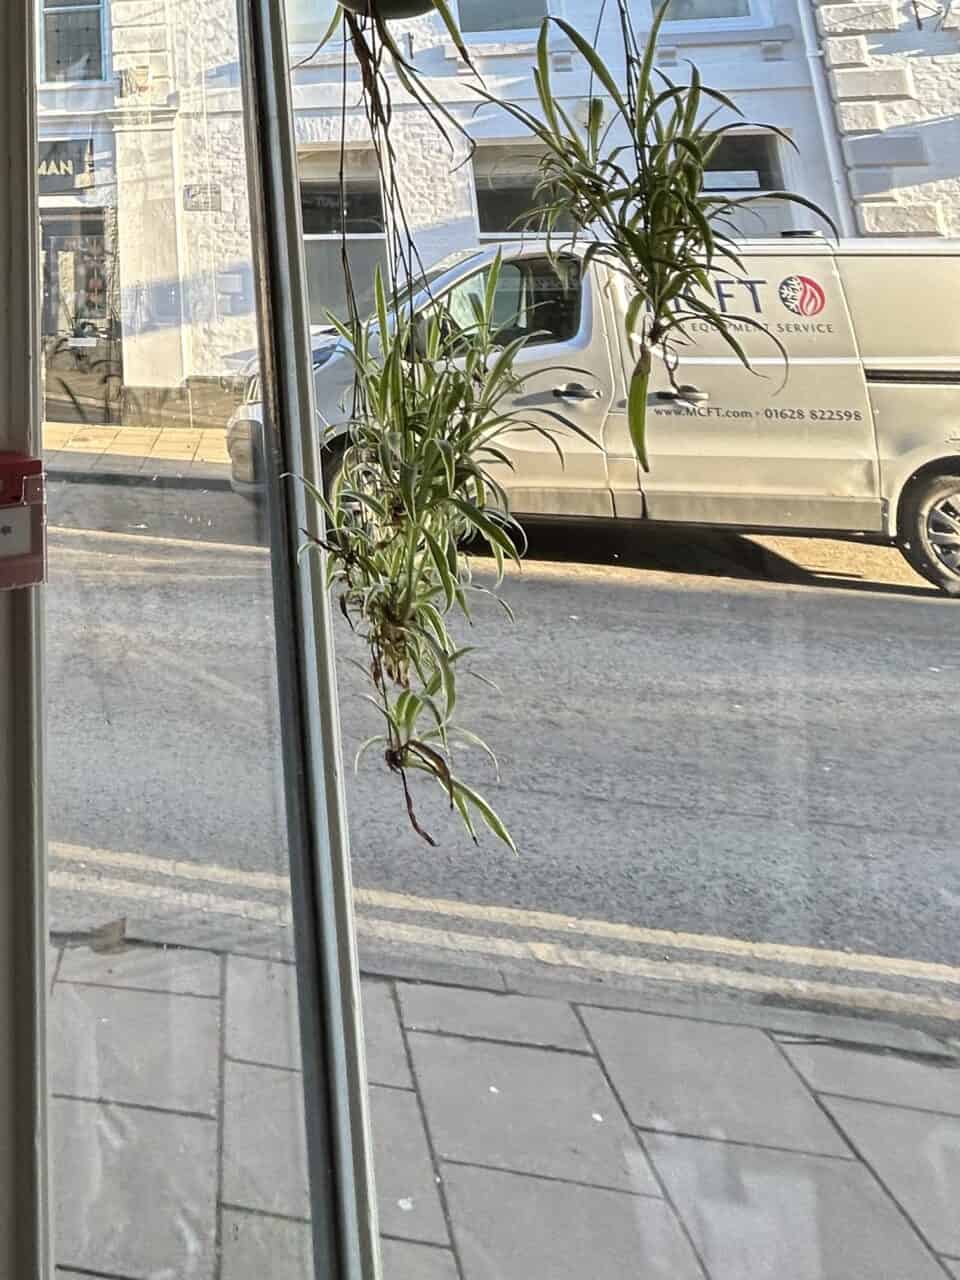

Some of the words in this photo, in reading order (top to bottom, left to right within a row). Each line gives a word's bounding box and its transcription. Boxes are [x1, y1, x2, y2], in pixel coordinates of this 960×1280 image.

[778, 323, 833, 333] SERVICE
[654, 406, 753, 419] www.MCFT.com
[764, 407, 805, 420] 01628
[810, 409, 863, 421] 822598
